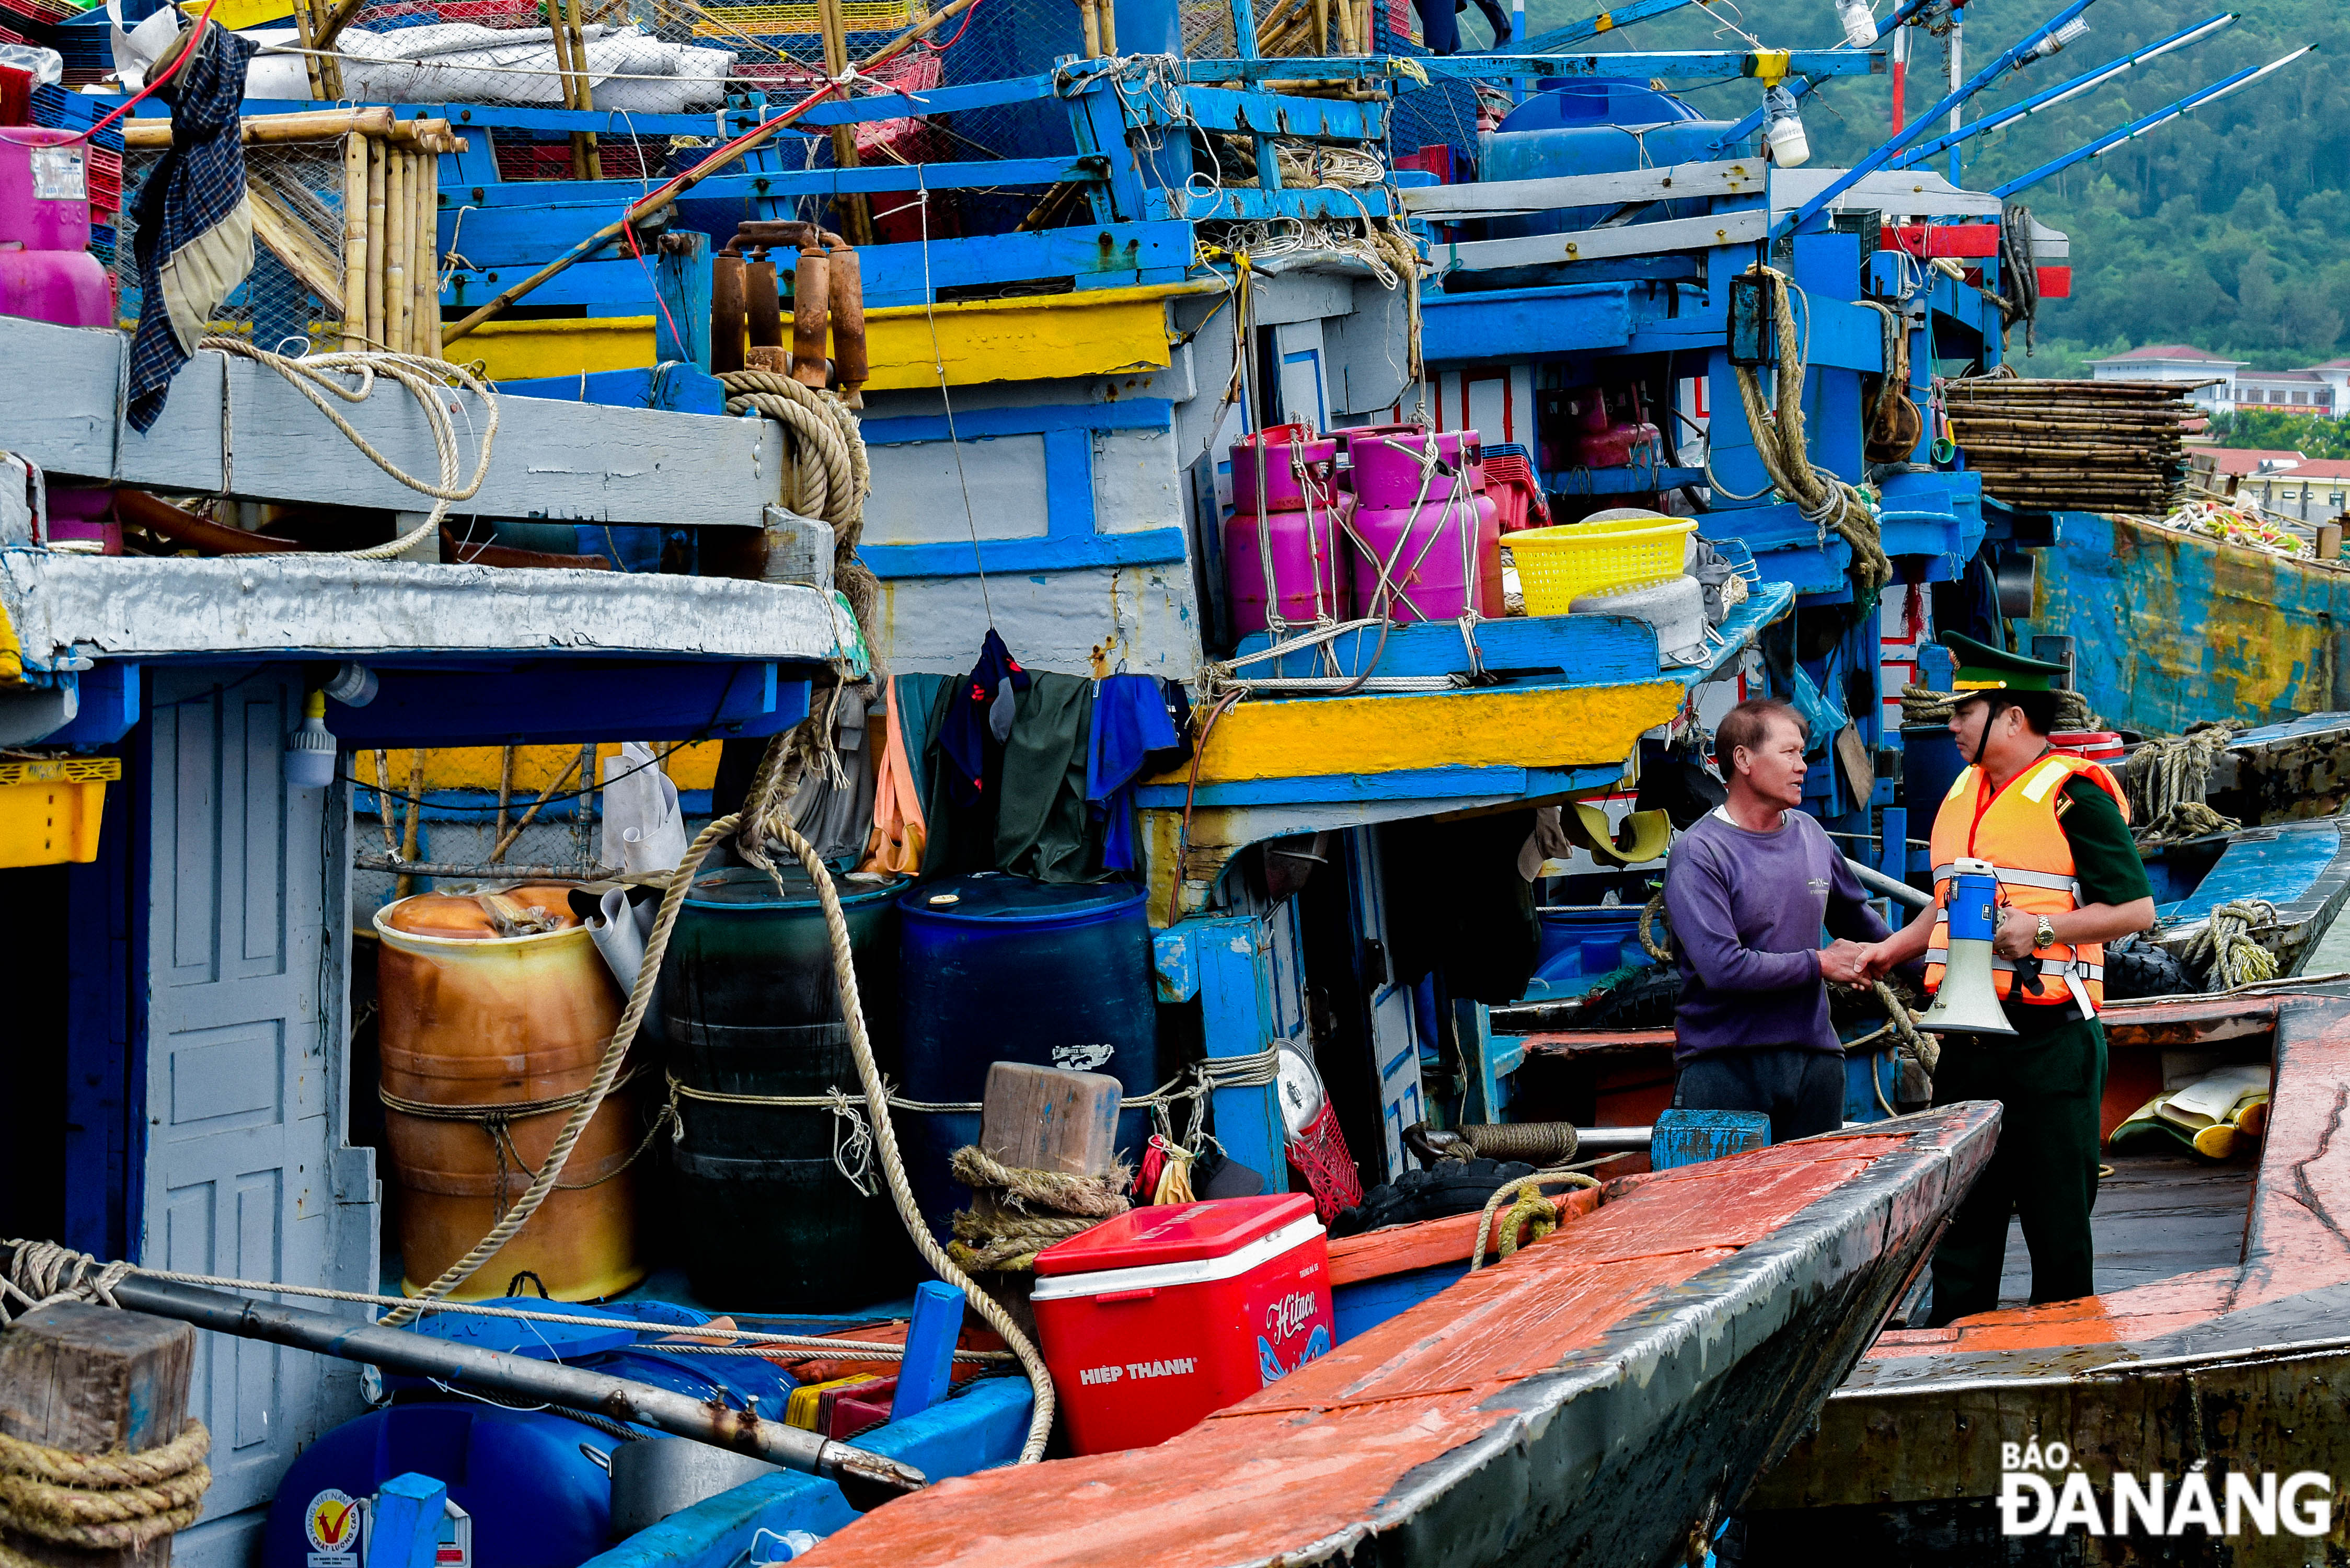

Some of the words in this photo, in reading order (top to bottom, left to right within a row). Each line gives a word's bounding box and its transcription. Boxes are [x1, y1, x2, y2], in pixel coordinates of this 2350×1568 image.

[1266, 1291, 1315, 1345] Hitaco
[1080, 1365, 1123, 1385] HIỆP
[1126, 1358, 1194, 1380] THÀNH
